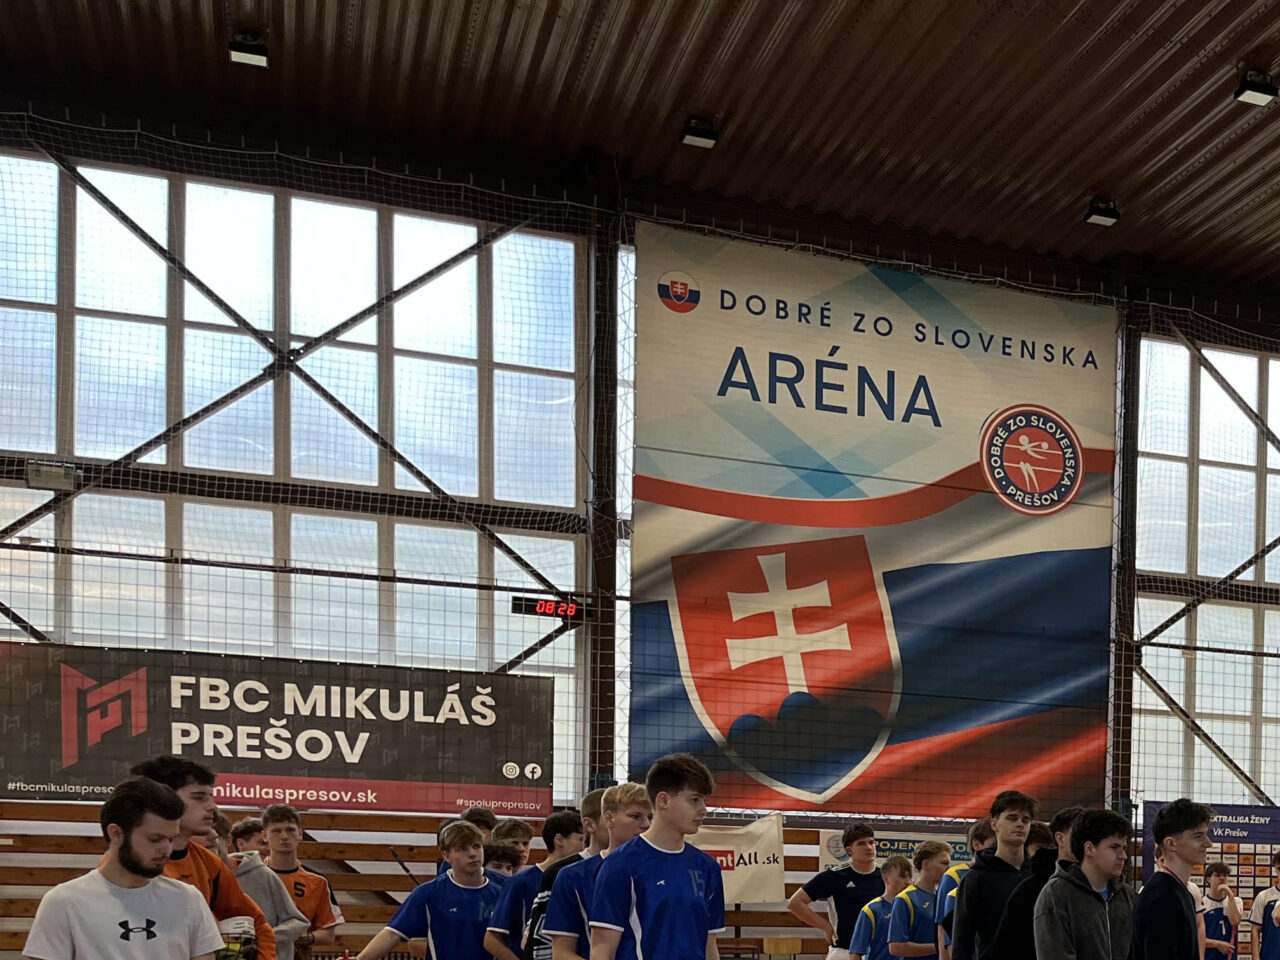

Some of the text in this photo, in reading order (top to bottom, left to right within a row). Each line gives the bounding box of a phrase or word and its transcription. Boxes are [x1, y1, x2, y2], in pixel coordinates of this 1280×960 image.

[719, 289, 1099, 370] DOBRÉ ZO SLOVENSKA
[716, 345, 943, 428] ARÉNA
[990, 415, 1076, 486] DOBRÉ ZO SLOVENSKA
[1006, 485, 1059, 507] PREŠOV
[169, 674, 497, 727] FBC MIKULÁŠ
[170, 717, 371, 764] PREŠOV
[1212, 828, 1249, 838] VK Prešov
[1250, 814, 1271, 825] ŽENY
[293, 881, 306, 898] 5
